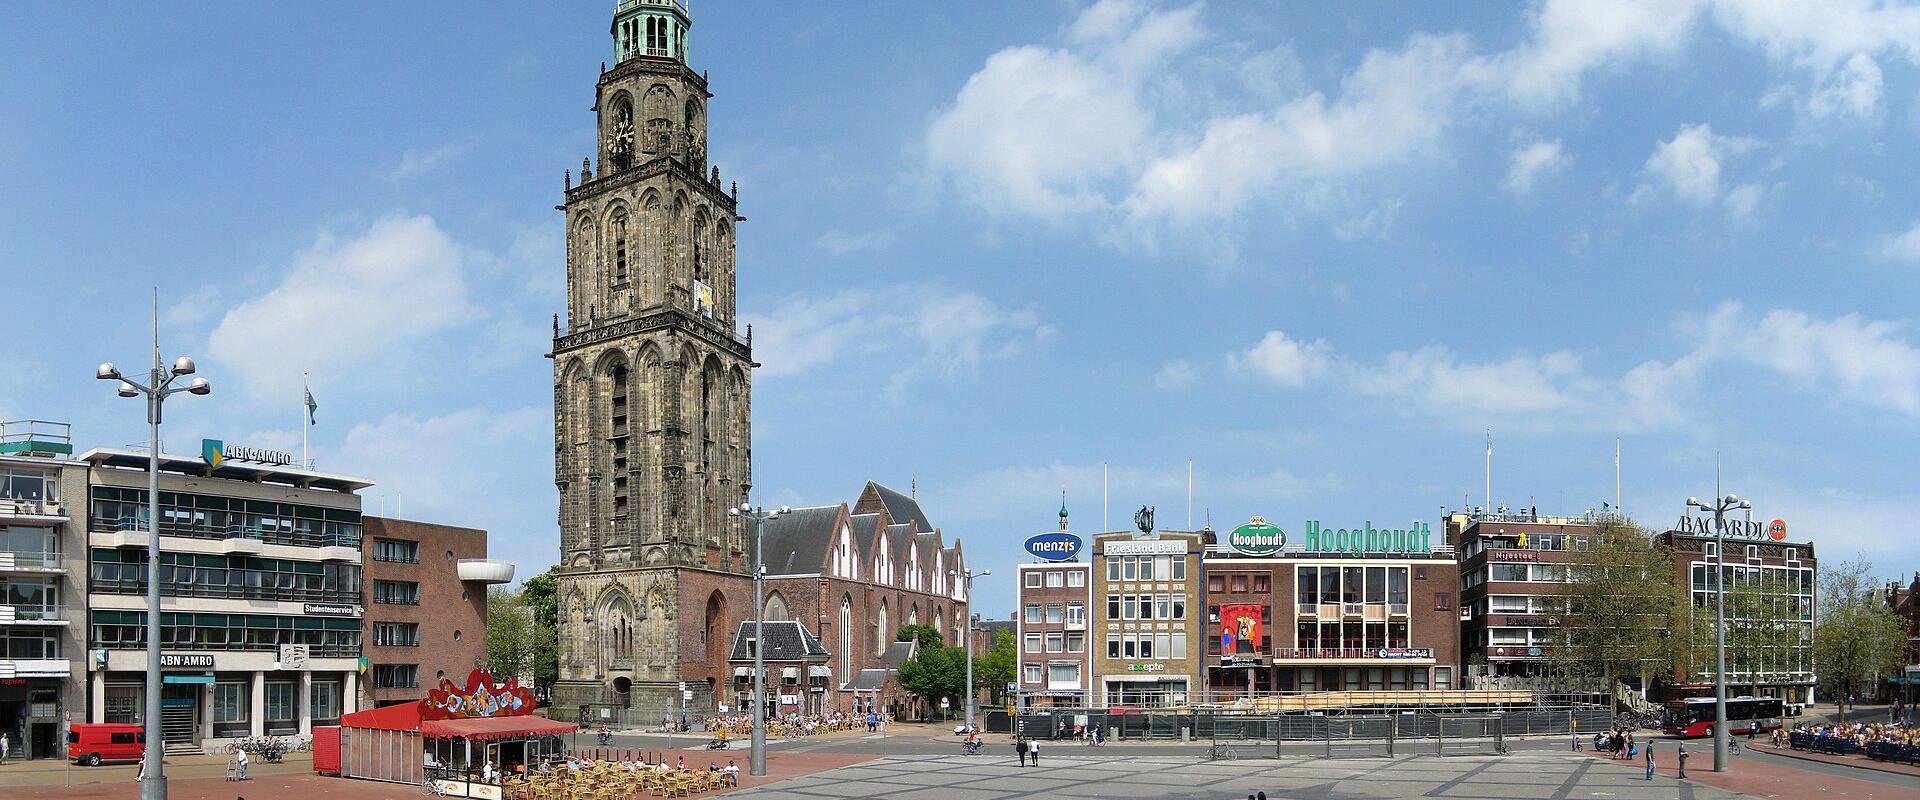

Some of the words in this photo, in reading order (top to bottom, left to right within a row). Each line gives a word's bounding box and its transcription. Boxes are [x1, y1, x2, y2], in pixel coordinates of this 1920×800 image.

[1233, 532, 1283, 547] Hooghoudt
[1305, 520, 1431, 557] Hooghoudt
[1032, 538, 1075, 553] menzis
[1105, 543, 1154, 553] Friesland
[1158, 543, 1185, 553] Bank
[1495, 552, 1533, 561] Nijestee
[305, 604, 353, 614] Studentenservice
